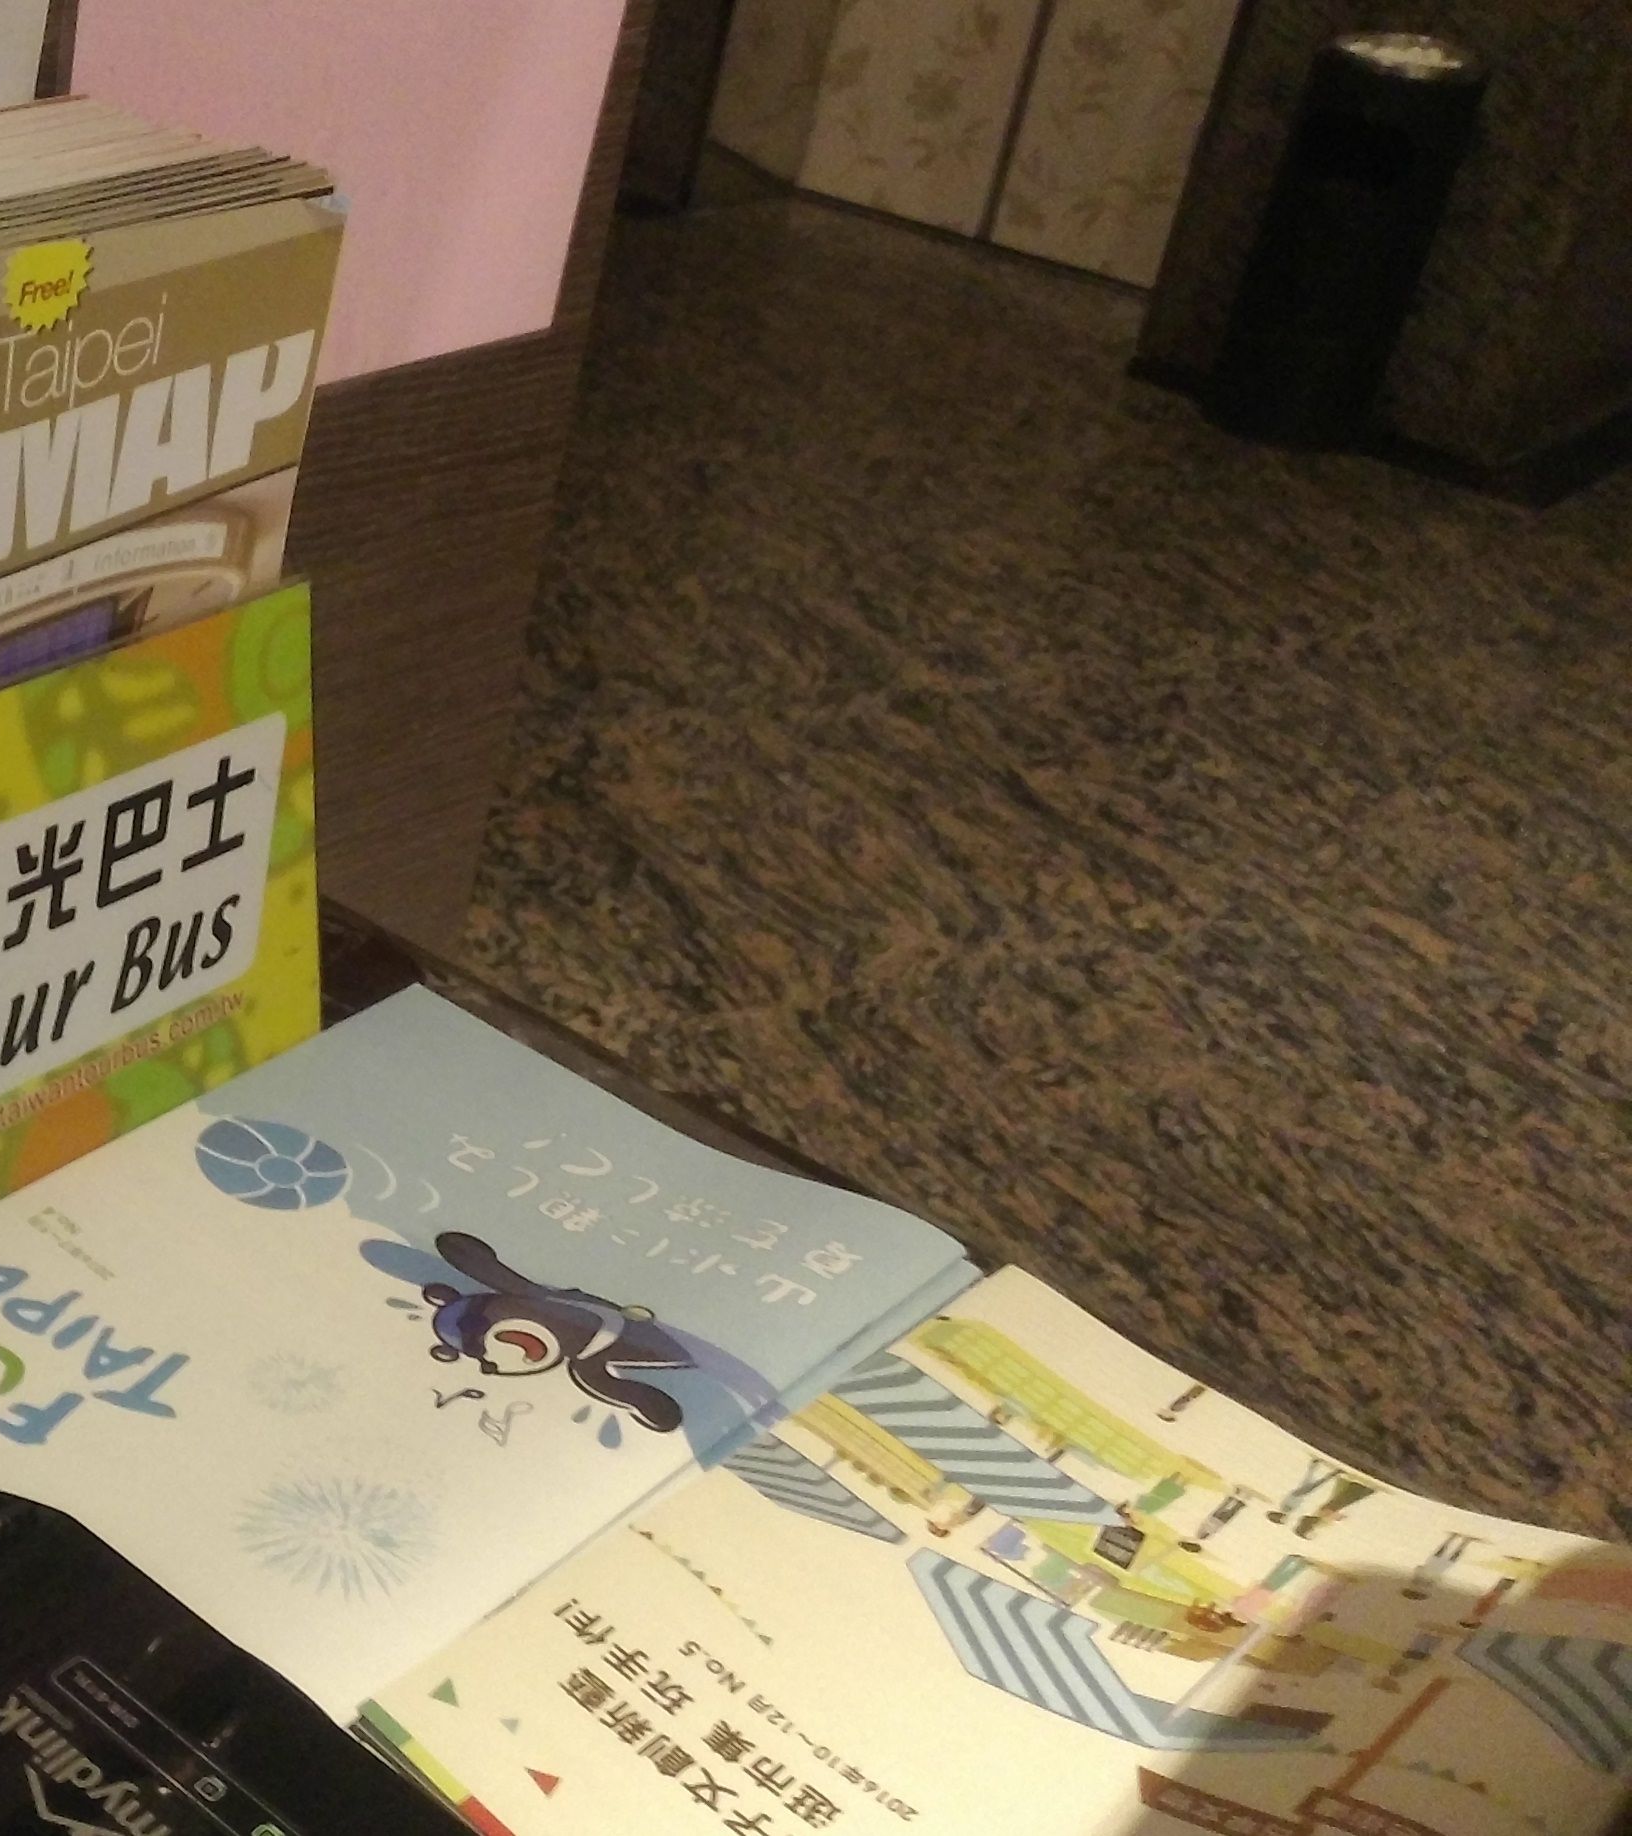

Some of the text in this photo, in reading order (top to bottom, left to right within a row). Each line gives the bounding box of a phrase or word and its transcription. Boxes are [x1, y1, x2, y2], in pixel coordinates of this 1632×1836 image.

[18, 273, 76, 306] Free!
[110, 893, 240, 1015] Bus
[678, 1640, 746, 1694] No.5
[701, 1719, 841, 1829] 逛市集
